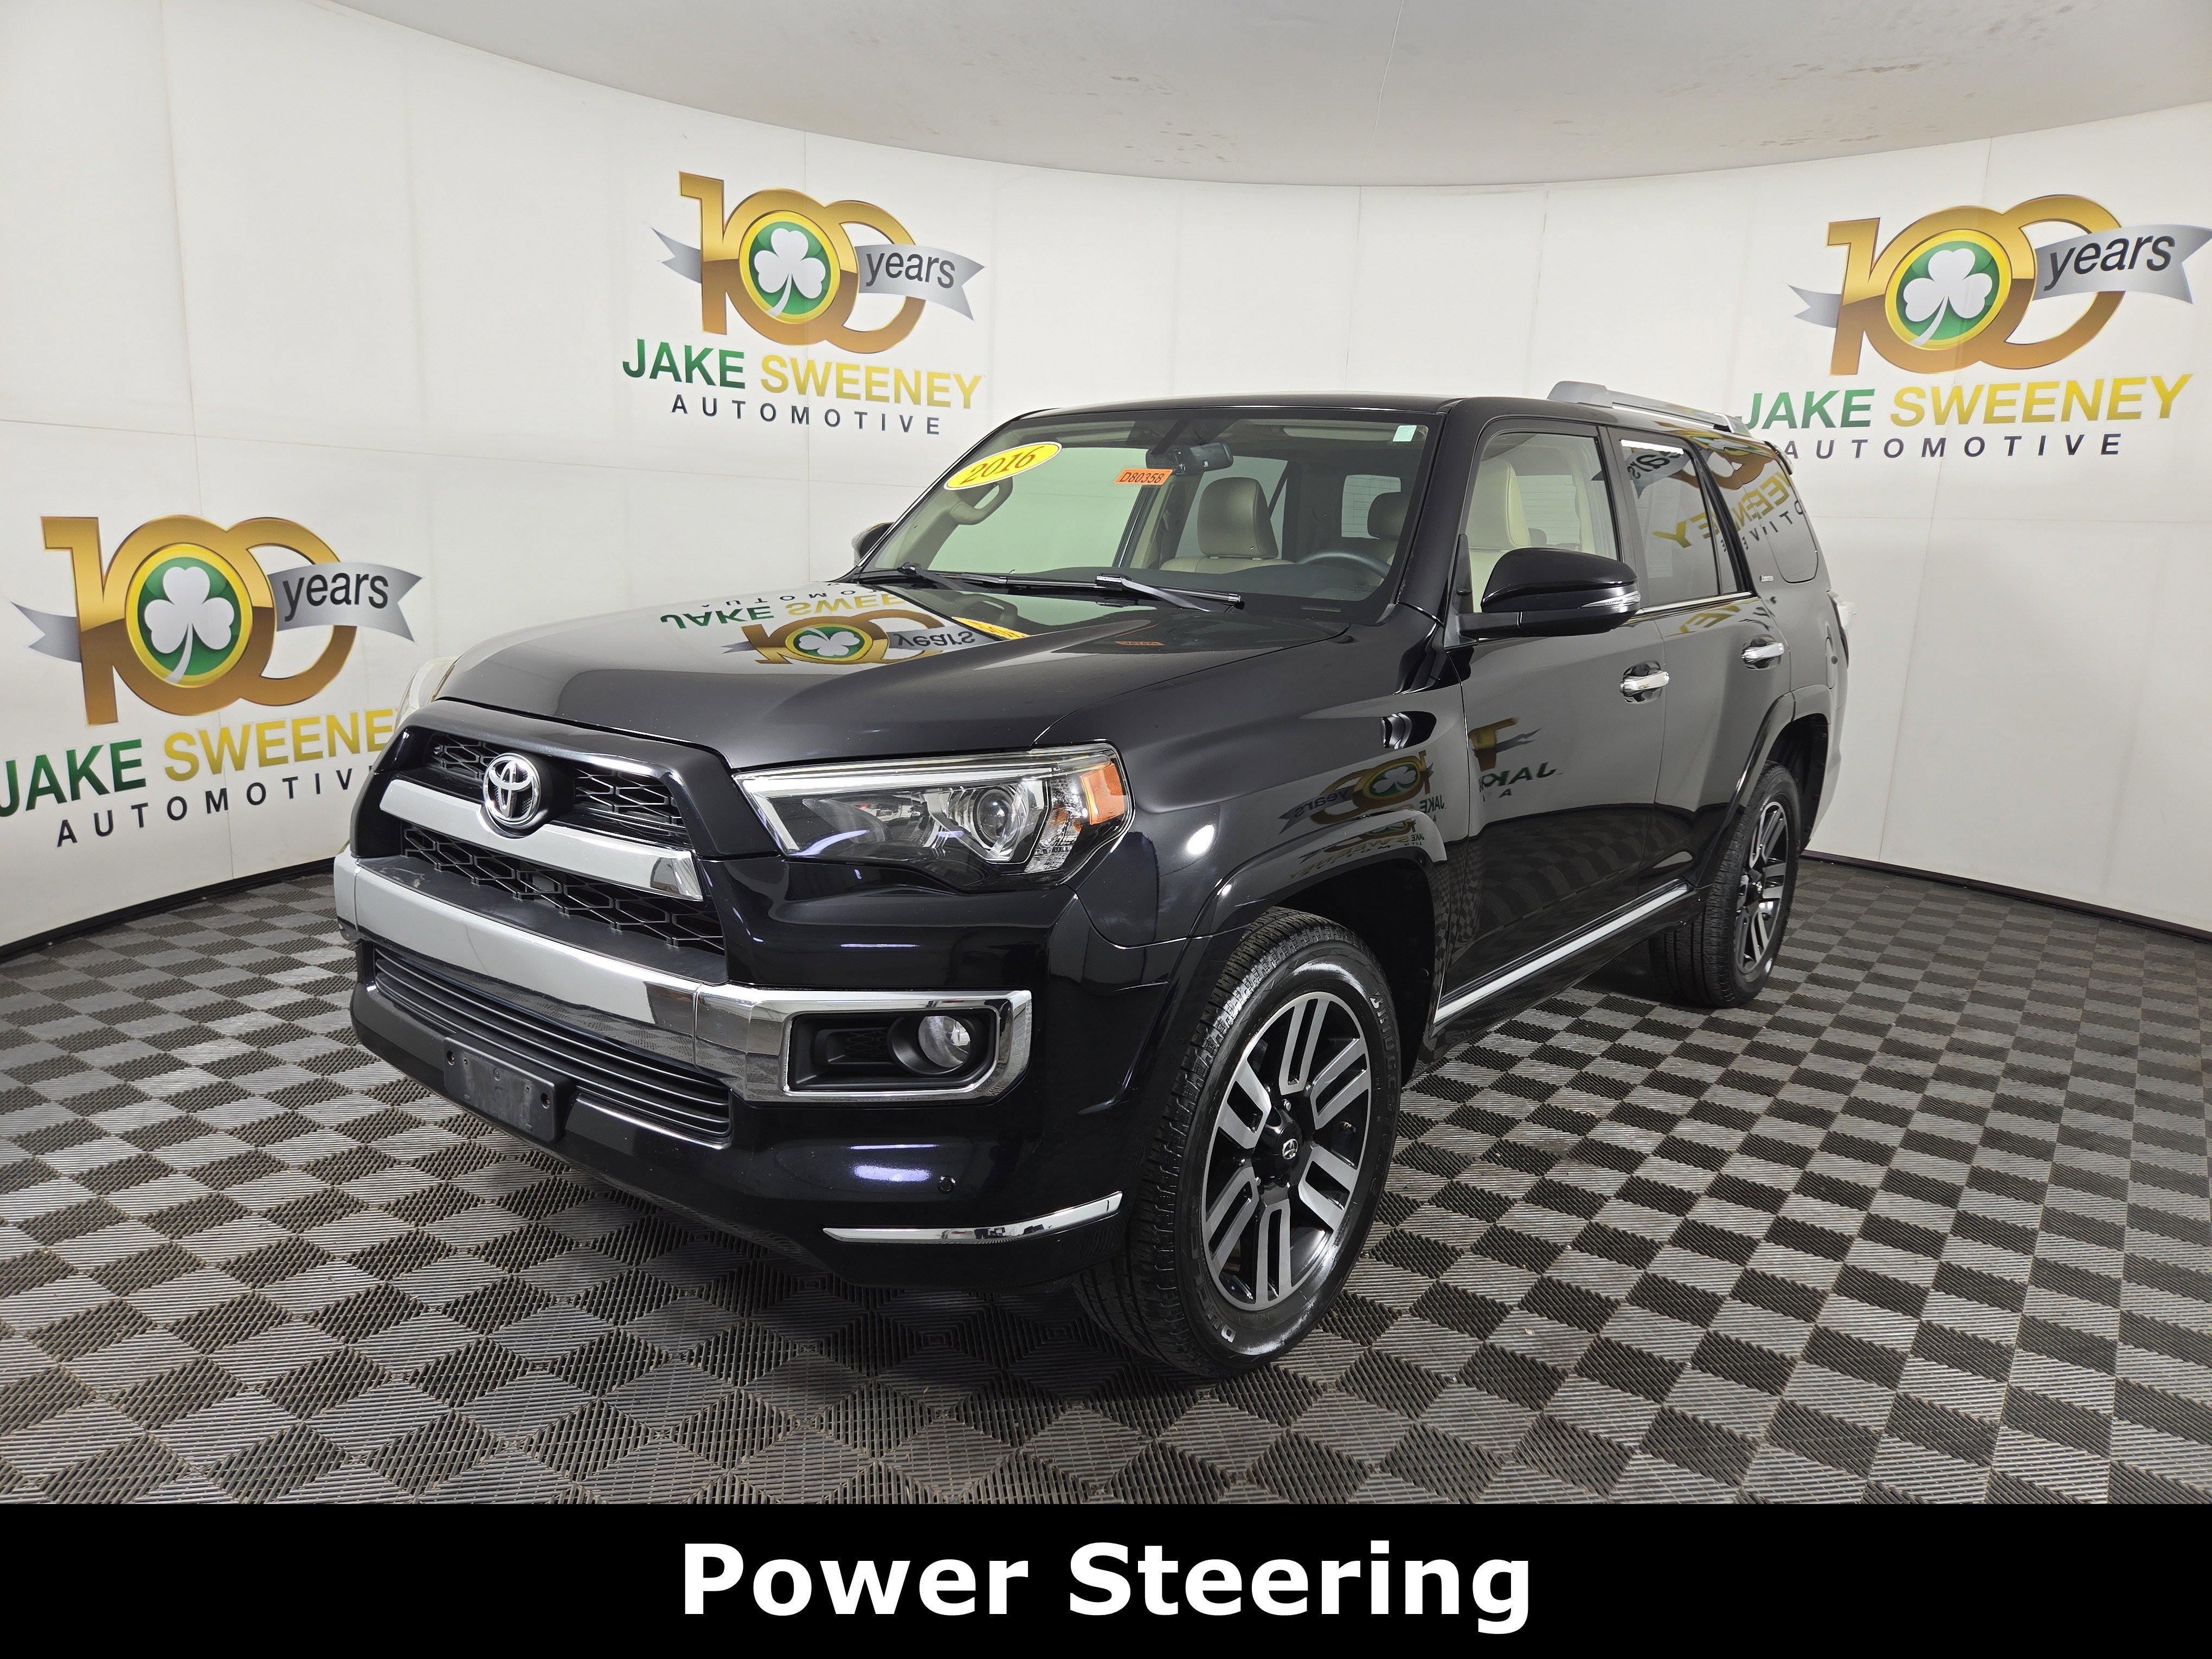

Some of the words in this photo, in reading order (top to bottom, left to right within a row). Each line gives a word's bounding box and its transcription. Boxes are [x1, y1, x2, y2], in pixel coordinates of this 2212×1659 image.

[679, 171, 925, 353] 100
[866, 252, 955, 288] years
[1826, 194, 2125, 376] 100
[2043, 235, 2176, 291] years
[623, 338, 745, 389] JAKE
[761, 355, 982, 409] SWEENEY
[672, 394, 940, 435] AUTOMOTIVE
[1735, 389, 1875, 430] JAKE
[1891, 374, 2193, 427] SWEENEY
[959, 446, 1045, 485] 2016
[1784, 434, 2121, 459] AUTOMOTIVE
[1119, 472, 1165, 483] D80358
[40, 514, 357, 726] 100
[282, 573, 389, 621] years
[0, 739, 146, 817] JAKE
[164, 708, 398, 781] SWEENE
[57, 766, 373, 847] AUTOMOTIV
